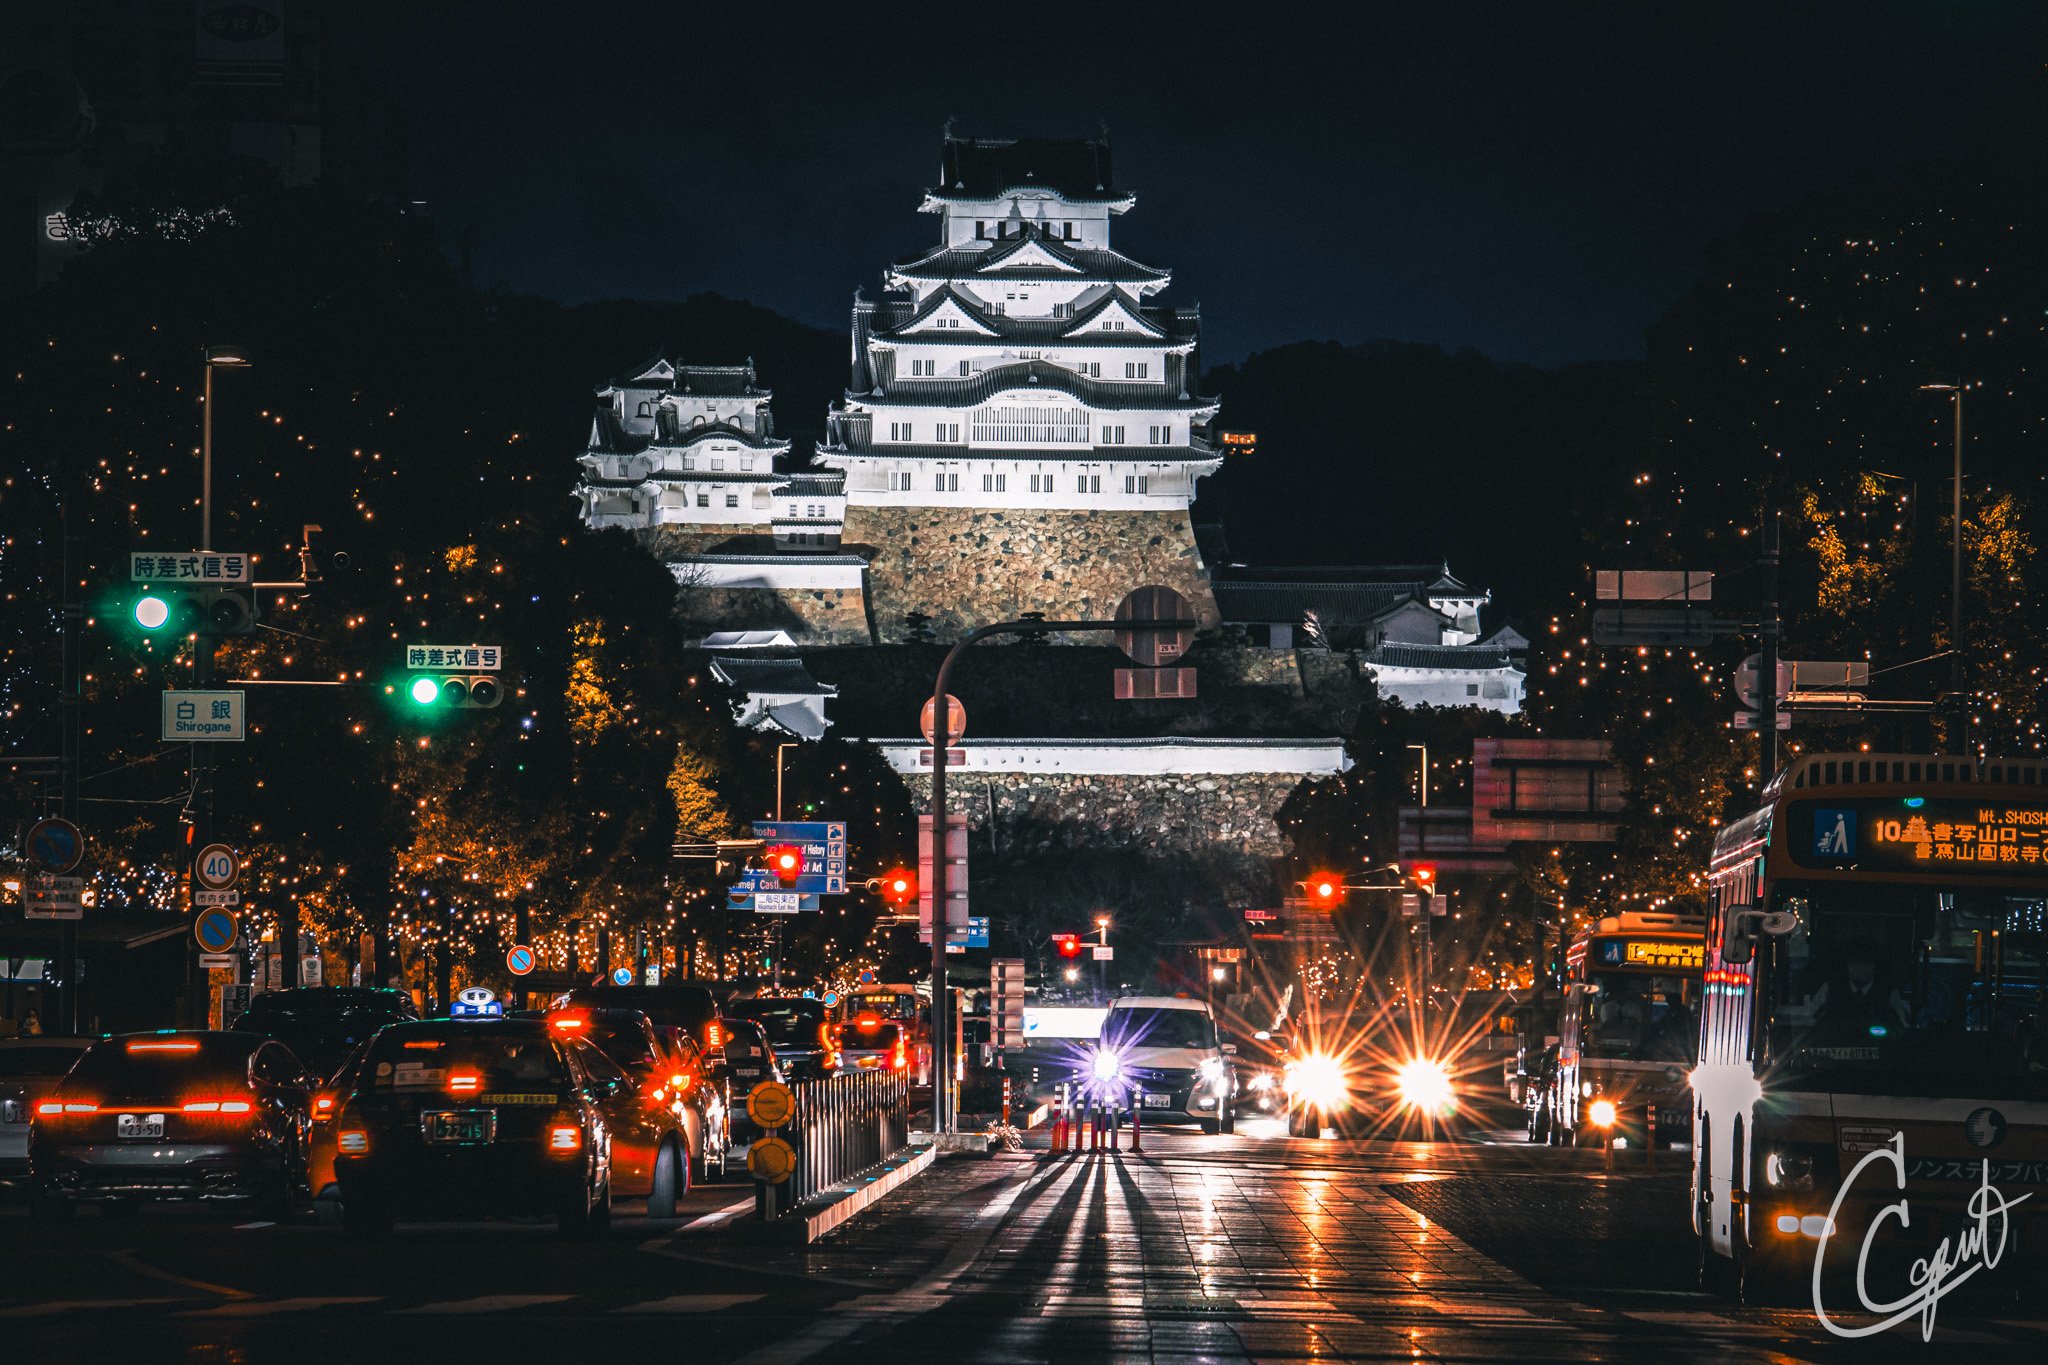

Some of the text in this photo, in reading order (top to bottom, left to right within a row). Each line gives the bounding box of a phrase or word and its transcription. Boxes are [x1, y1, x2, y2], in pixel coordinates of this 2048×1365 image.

[135, 556, 243, 579] 時差式信号
[410, 648, 498, 667] 時差式信号
[177, 700, 231, 720] 白銀
[176, 721, 231, 734] Shirogane
[1876, 820, 1901, 842] 10
[801, 844, 807, 855] of
[807, 844, 826, 857] History
[207, 857, 229, 877] 40
[802, 862, 810, 873] of
[812, 861, 823, 873] Art
[128, 1124, 162, 1136] 23-50
[1908, 1160, 2048, 1182] ノンステップバ
